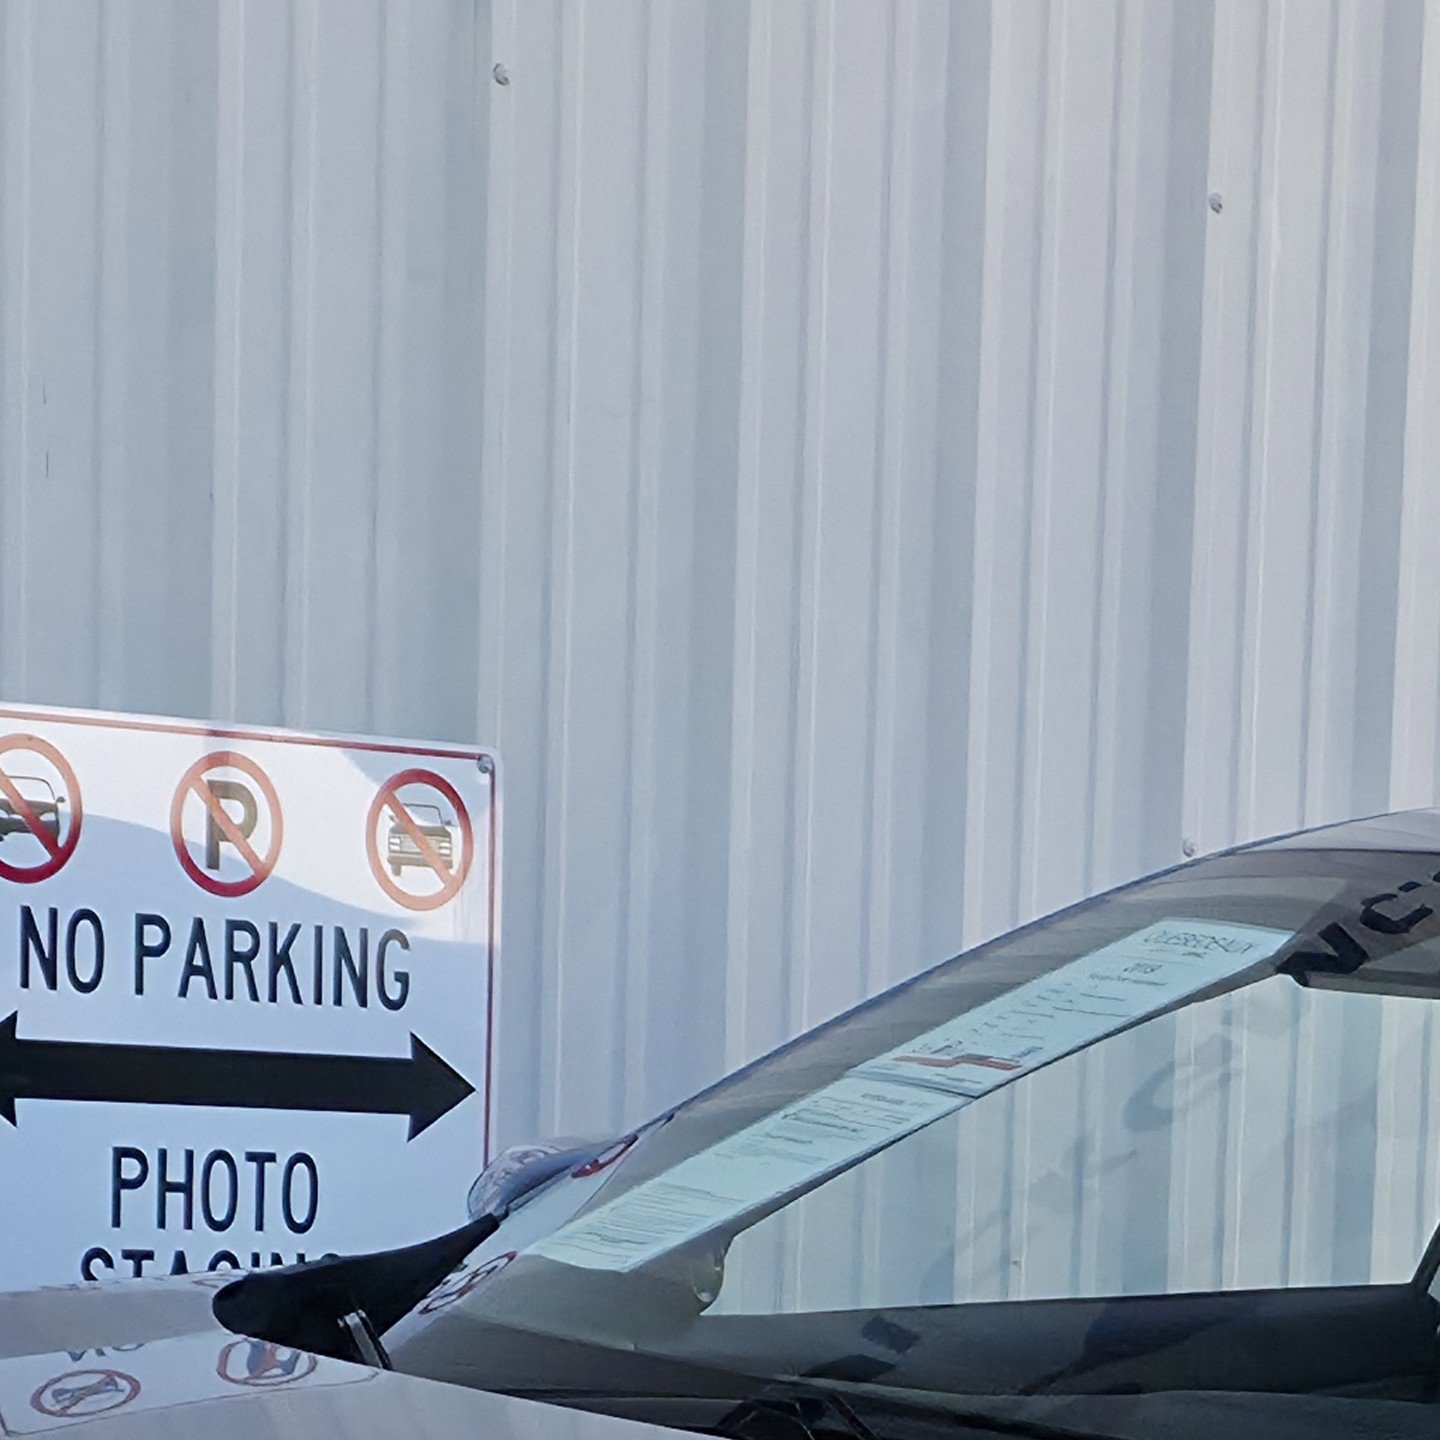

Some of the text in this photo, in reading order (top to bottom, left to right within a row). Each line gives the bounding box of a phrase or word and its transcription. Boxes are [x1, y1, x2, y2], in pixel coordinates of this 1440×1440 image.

[19, 905, 411, 1012] NO PARKING
[111, 1146, 319, 1234] PHOTO
